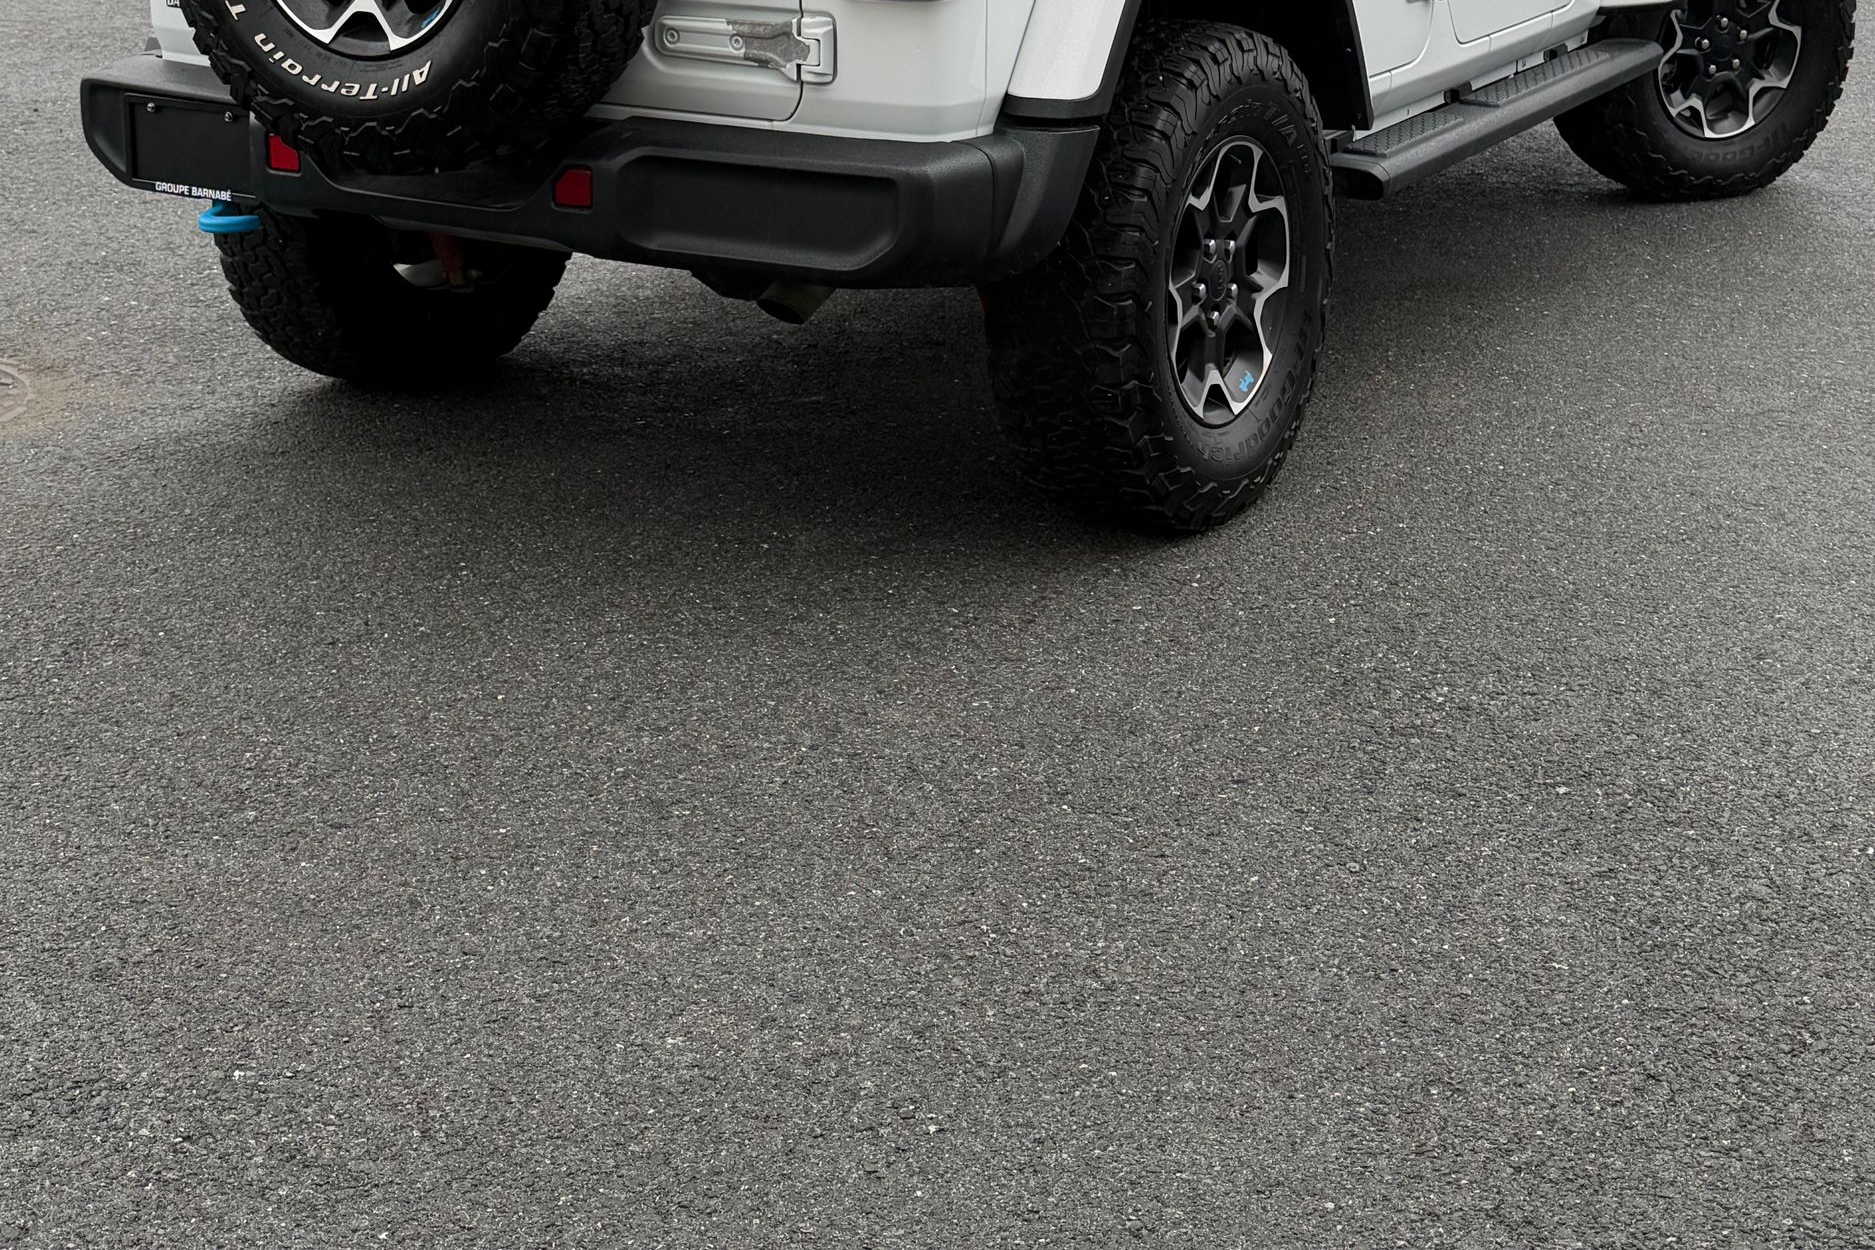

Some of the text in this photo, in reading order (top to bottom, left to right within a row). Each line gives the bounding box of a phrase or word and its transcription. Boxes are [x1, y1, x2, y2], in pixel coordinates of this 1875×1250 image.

[254, 33, 432, 100] All-Terrain
[155, 181, 232, 202] GROUPE BARNABÉ
